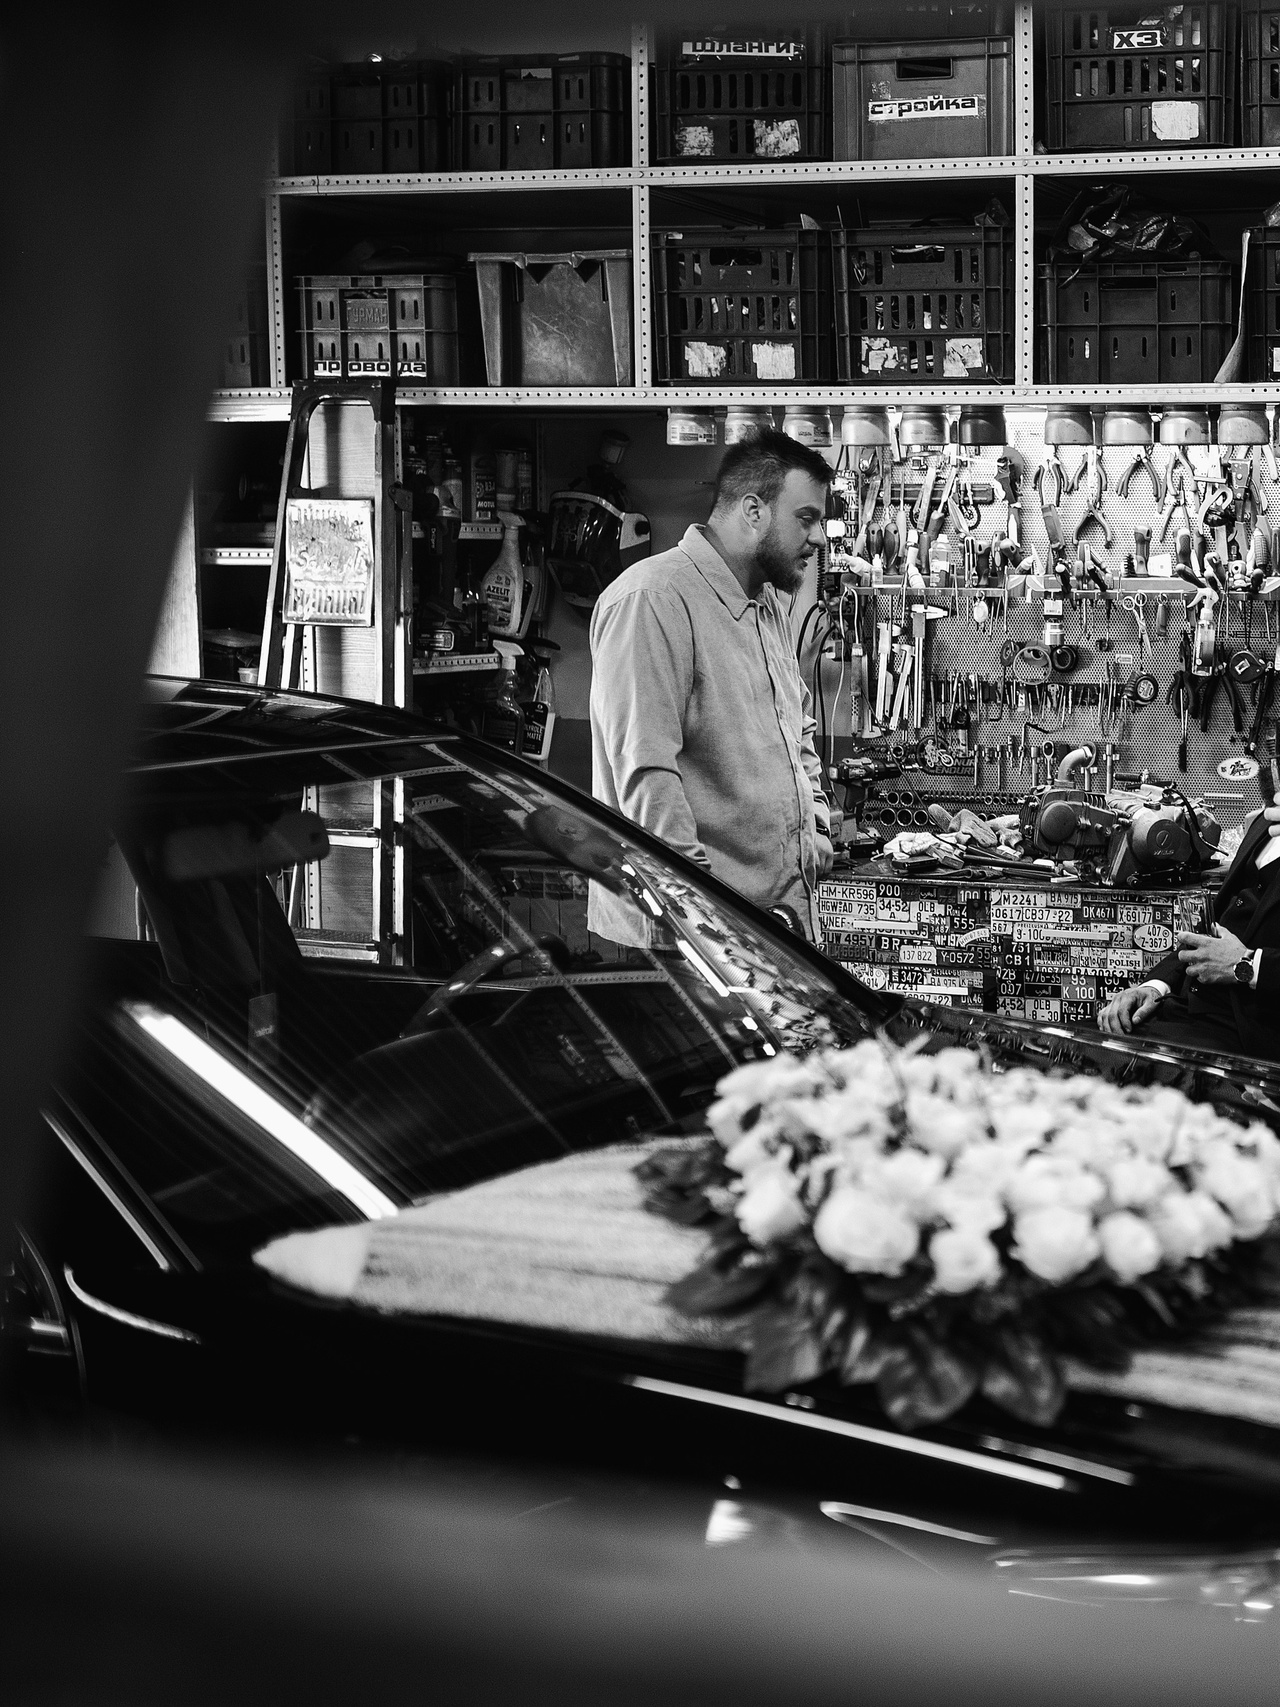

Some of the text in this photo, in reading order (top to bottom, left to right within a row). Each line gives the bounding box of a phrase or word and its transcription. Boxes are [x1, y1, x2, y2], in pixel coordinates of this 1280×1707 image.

[870, 95, 976, 117] стройка
[486, 584, 510, 597] AZELIT
[526, 731, 542, 742] MATTE
[879, 883, 901, 897] 900
[858, 903, 875, 915] 735
[1108, 958, 1141, 968] POLISH
